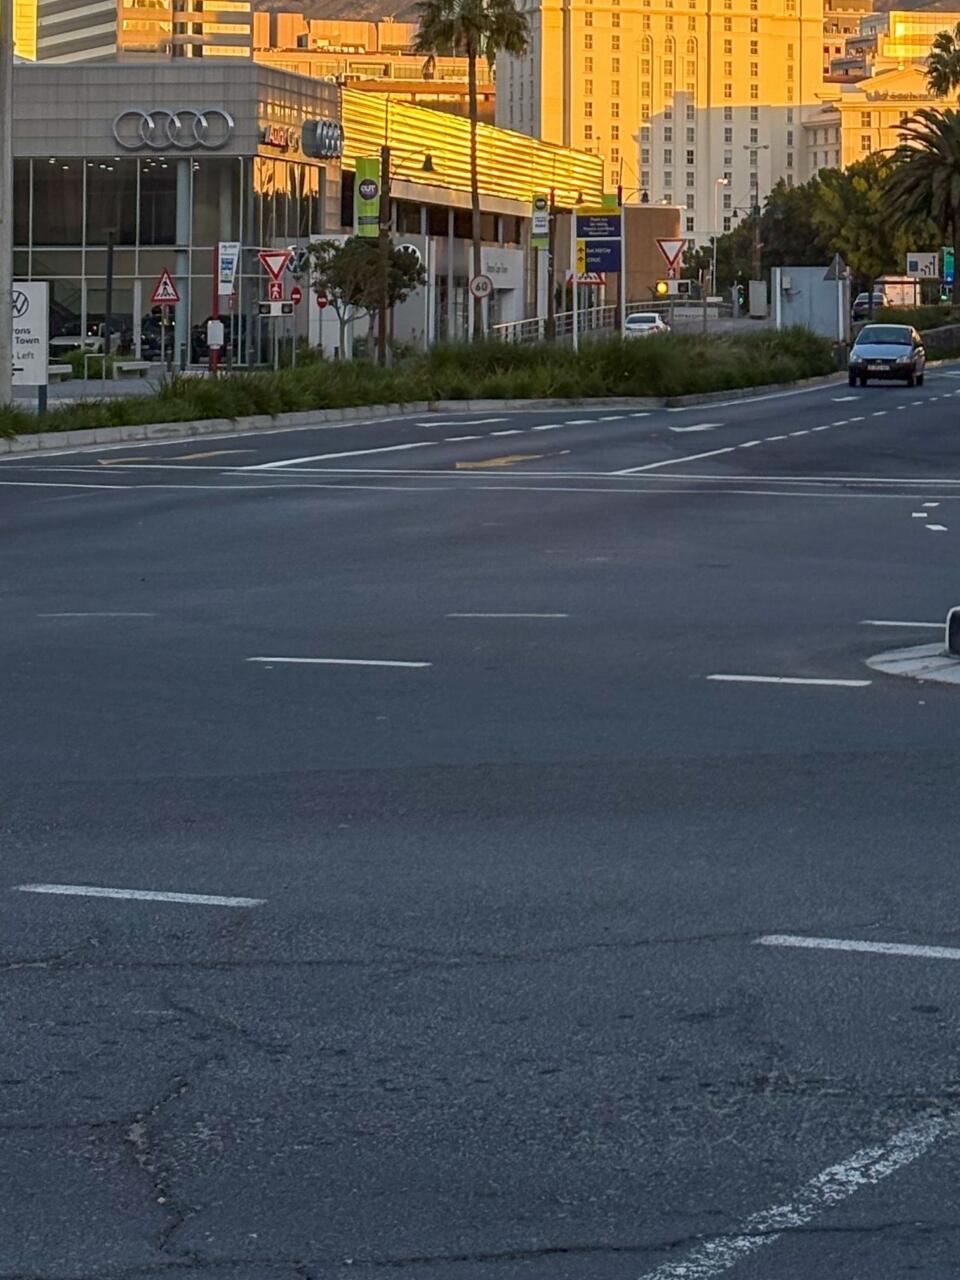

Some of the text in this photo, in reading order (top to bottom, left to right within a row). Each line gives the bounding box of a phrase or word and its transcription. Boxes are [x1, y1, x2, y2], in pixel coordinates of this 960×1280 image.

[475, 281, 488, 292] 60
[14, 327, 31, 335] ons
[16, 336, 40, 345] Town
[17, 352, 35, 360] Left
